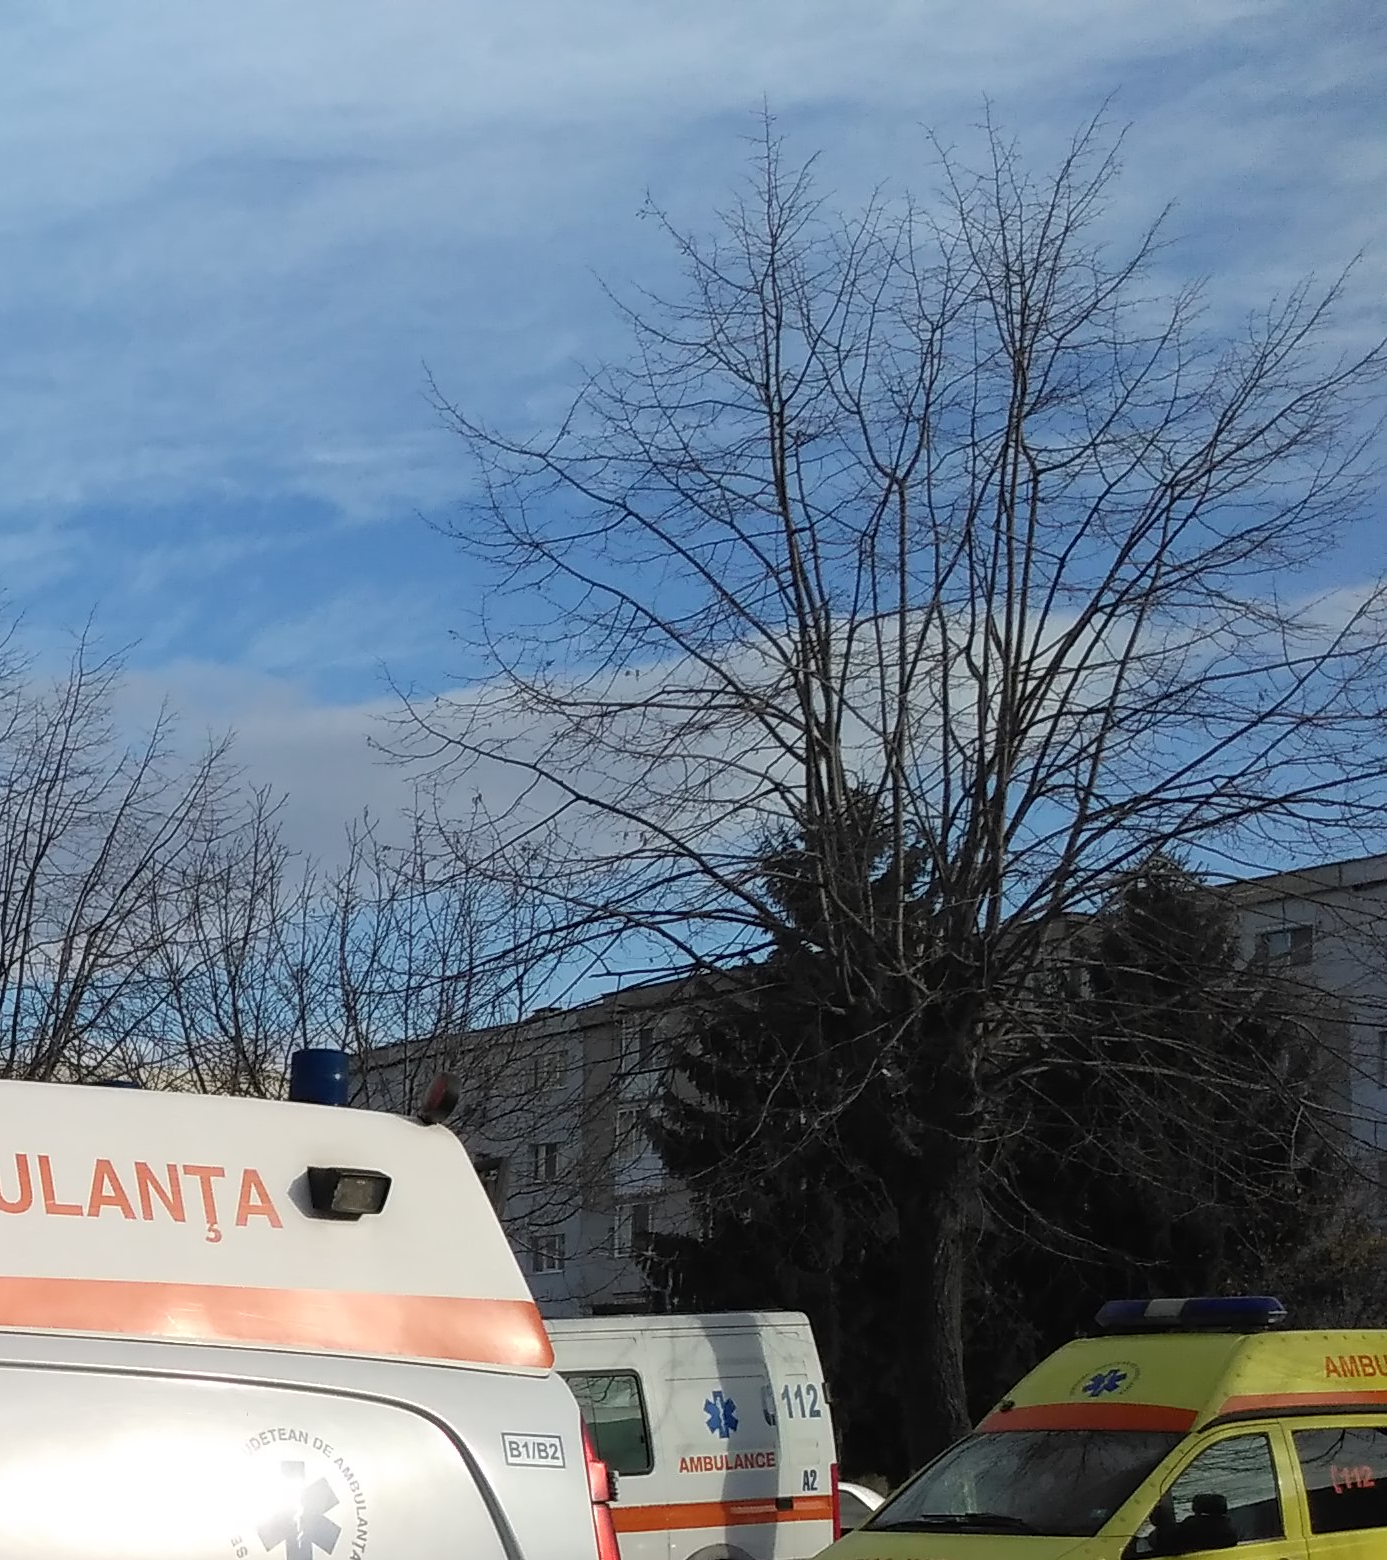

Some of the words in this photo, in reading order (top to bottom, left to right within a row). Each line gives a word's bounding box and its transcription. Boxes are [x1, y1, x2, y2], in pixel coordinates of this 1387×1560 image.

[782, 1384, 821, 1418] 112
[313, 1438, 334, 1457] DE
[508, 1439, 561, 1462] B1/B2
[679, 1452, 776, 1473] AMBULANCE
[802, 1470, 818, 1491] A2
